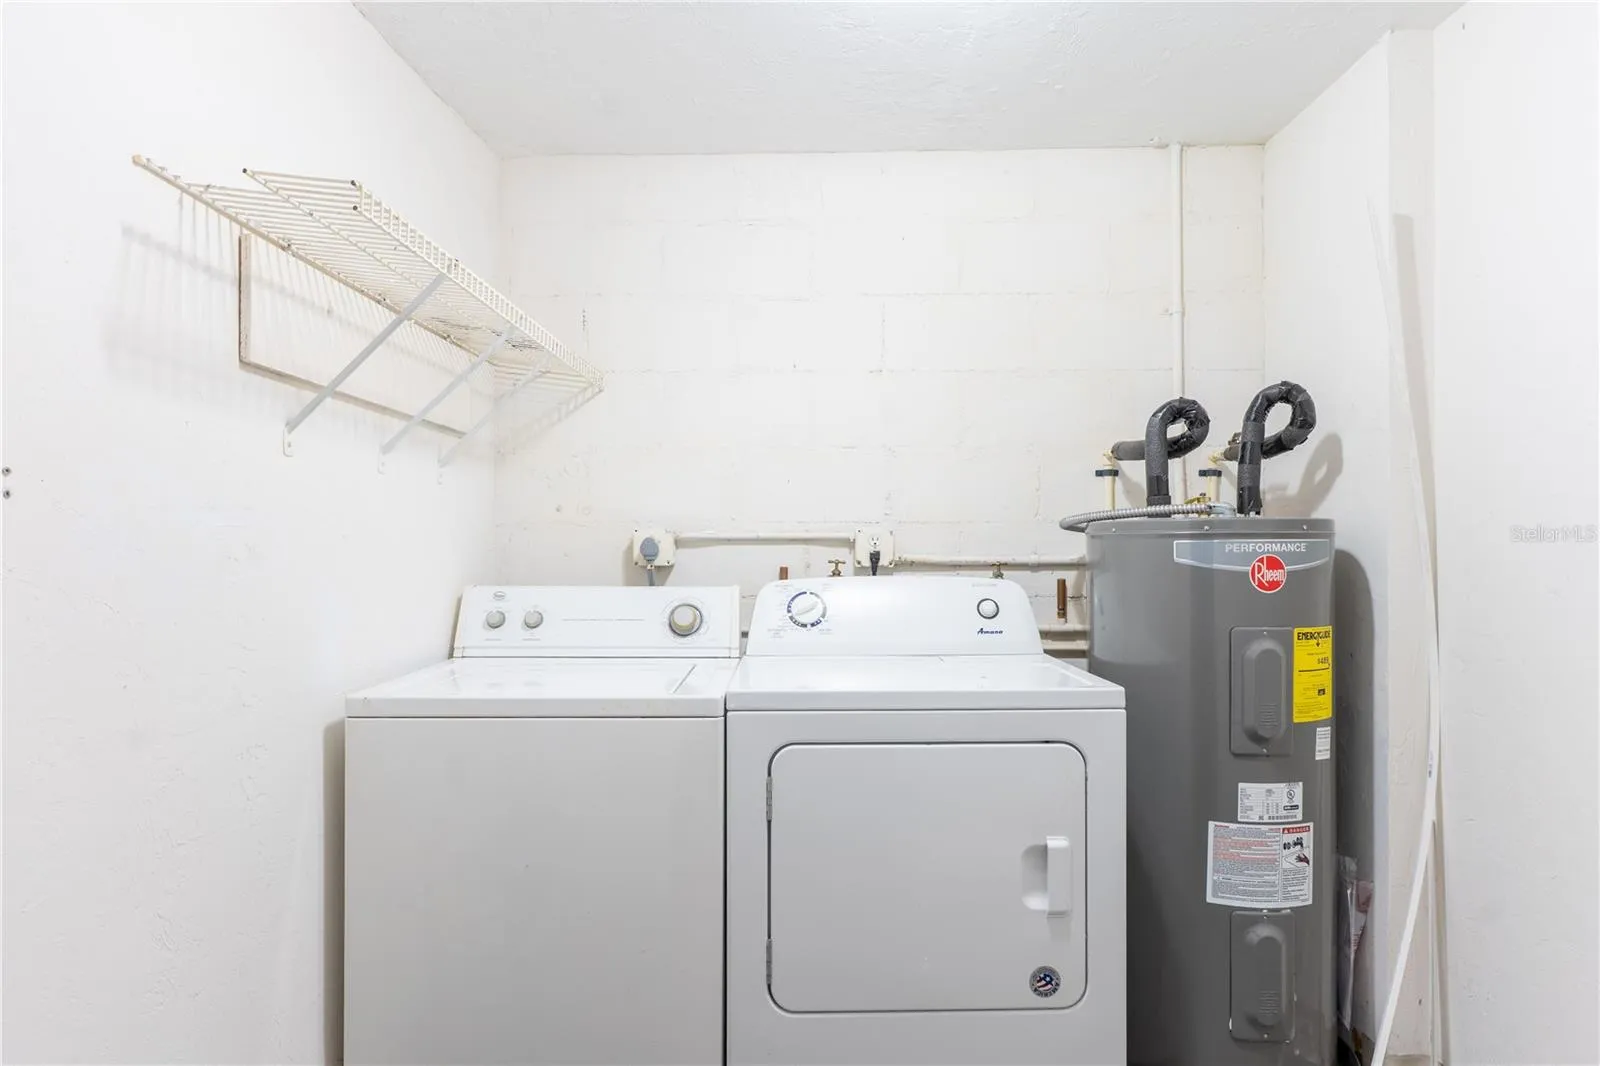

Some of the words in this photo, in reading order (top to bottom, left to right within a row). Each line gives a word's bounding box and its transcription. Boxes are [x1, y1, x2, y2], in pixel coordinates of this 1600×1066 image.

[1225, 542, 1307, 553] PERFORMANCE
[1254, 555, 1285, 587] Rheem
[977, 627, 1003, 636] Amana
